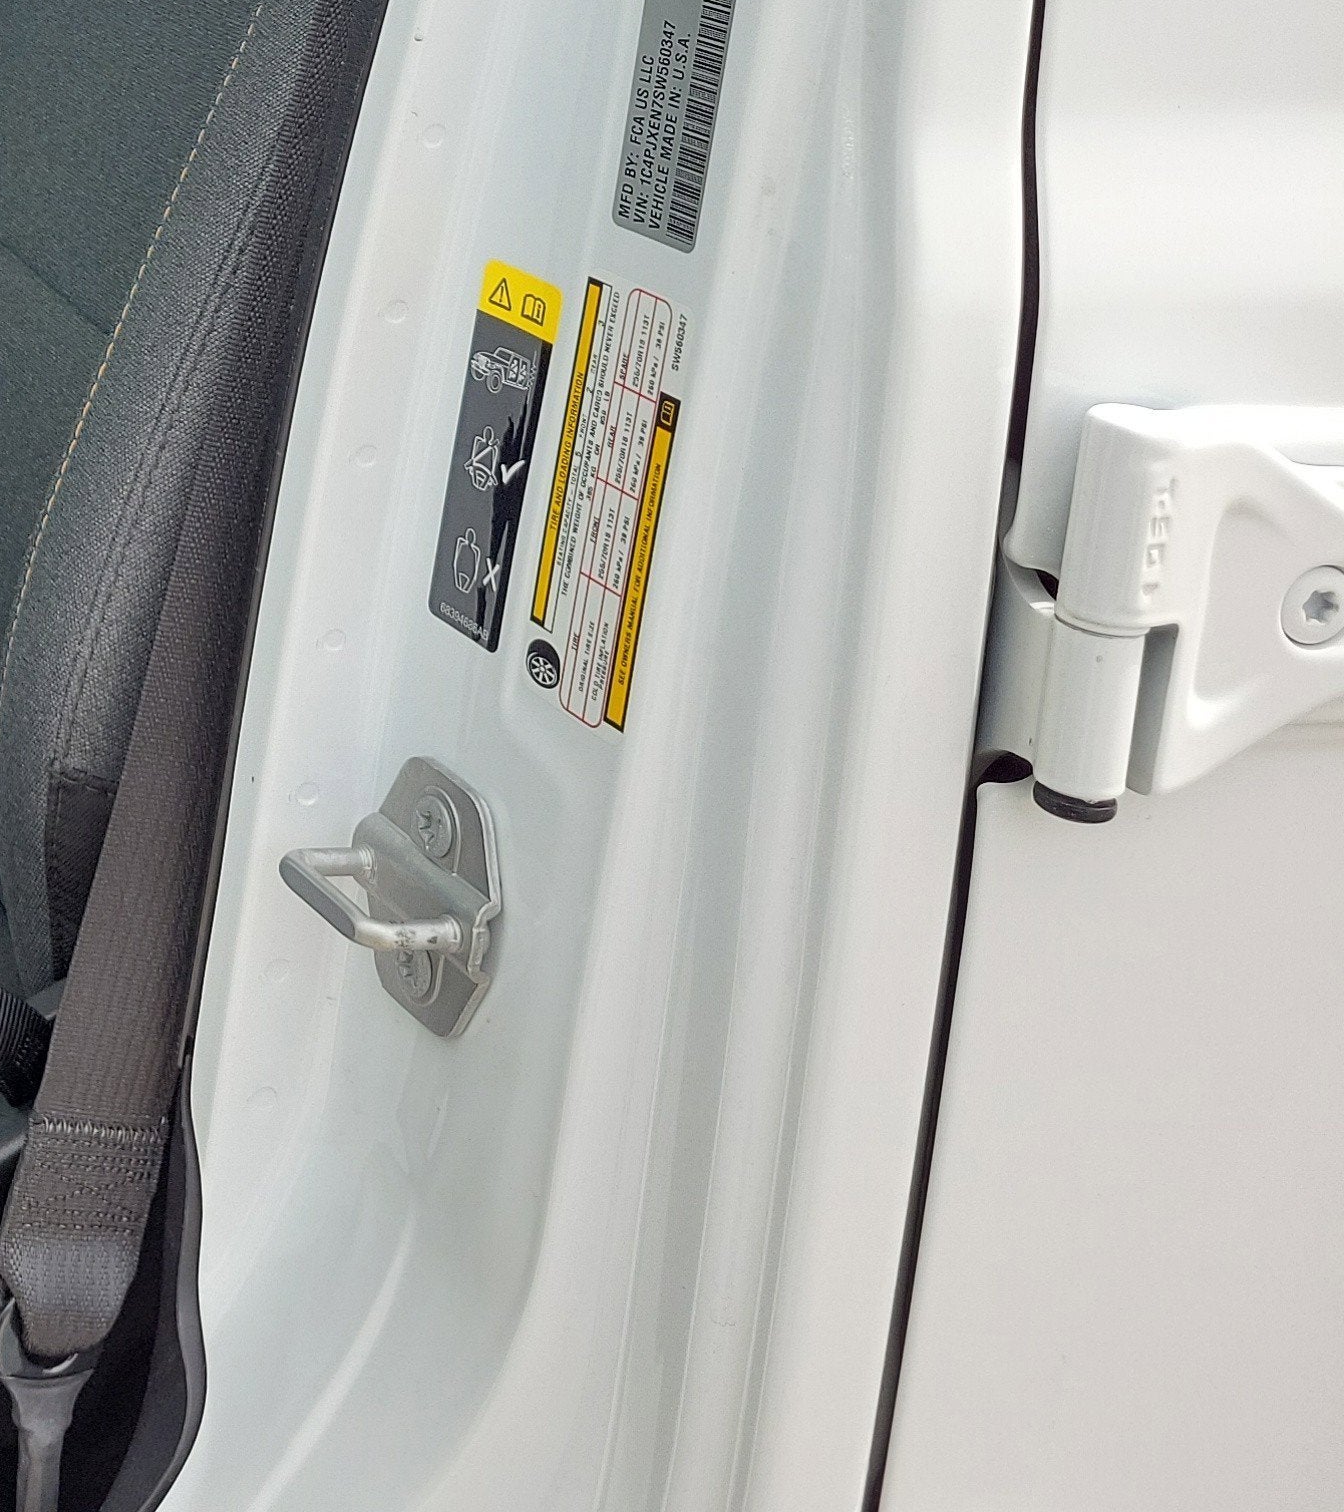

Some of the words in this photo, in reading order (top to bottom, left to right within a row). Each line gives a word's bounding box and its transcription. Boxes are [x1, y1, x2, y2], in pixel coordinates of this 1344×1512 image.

[638, 53, 654, 83] LLC
[671, 30, 691, 81] U.S.A.
[634, 86, 649, 110] US
[639, 19, 676, 188] 1C4PJXEN7SW560347
[667, 85, 682, 109] IN:
[629, 113, 645, 145] FCA
[659, 112, 678, 161] MADE
[624, 151, 639, 178] BY:
[618, 182, 634, 219] MFD
[633, 190, 649, 225] VIN:
[648, 163, 670, 231] VEHICLE
[671, 313, 688, 372] SW560347
[566, 371, 583, 439] INFORMATION
[558, 440, 571, 483] LOADING
[554, 484, 563, 507] AND
[549, 509, 558, 531] TIRE
